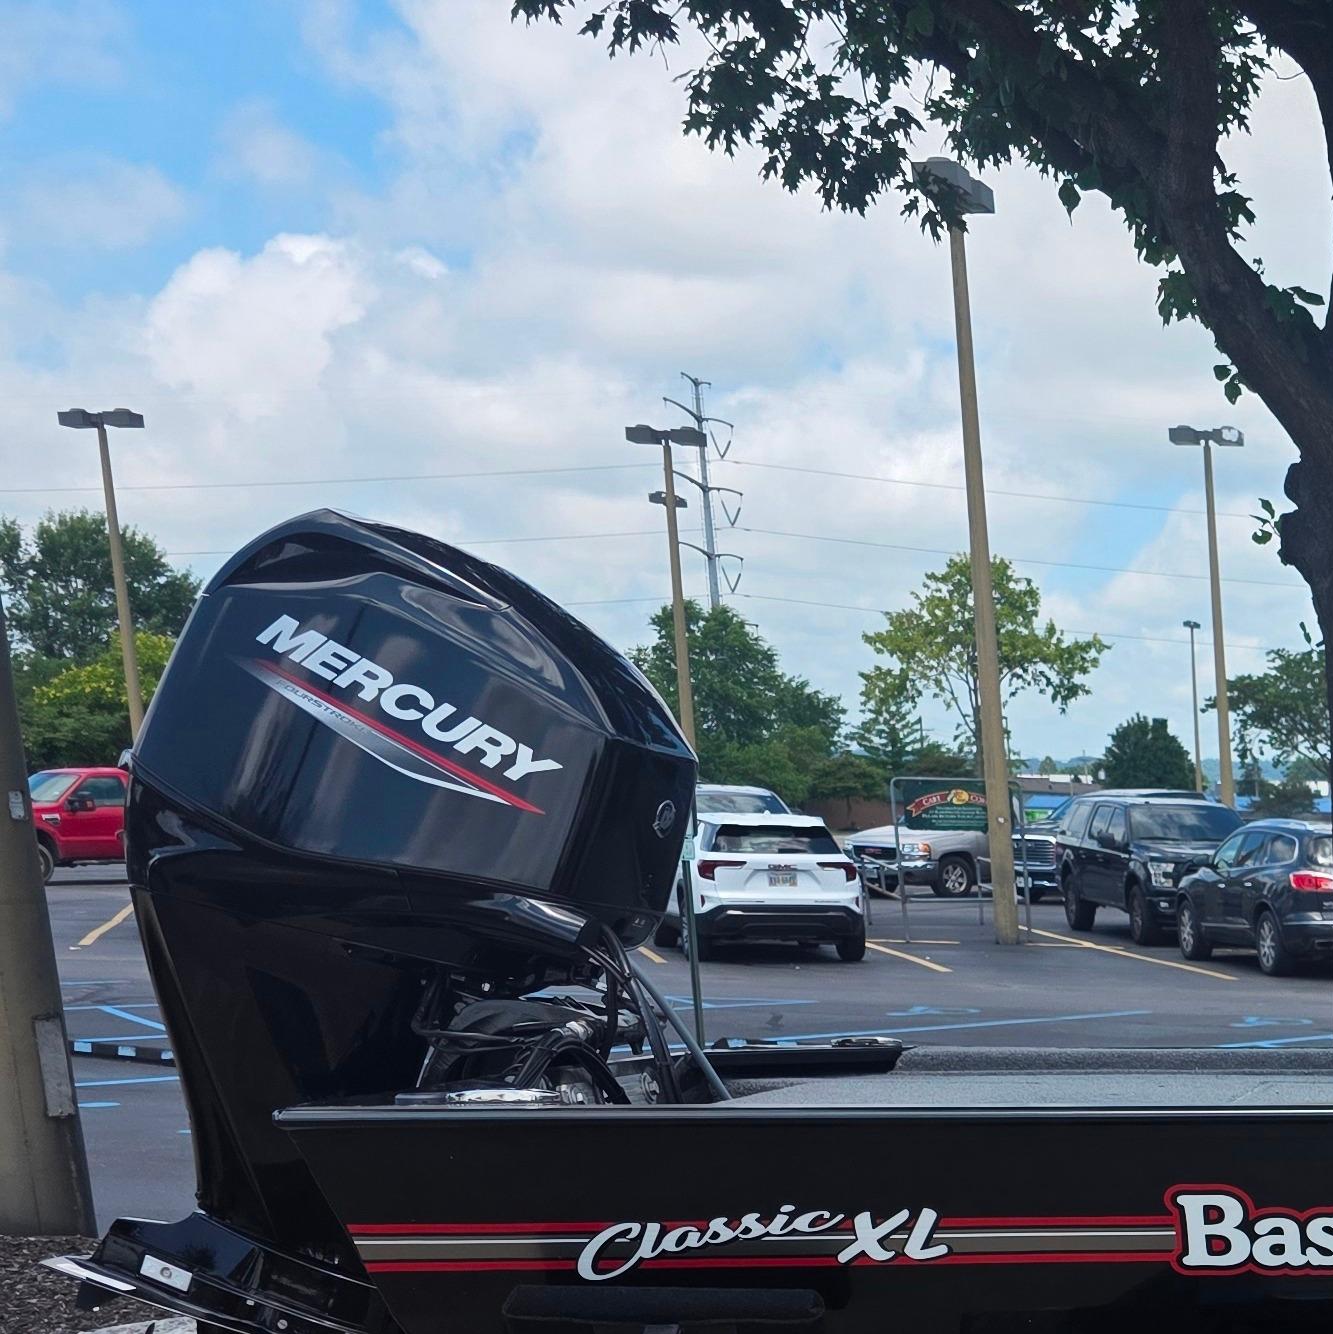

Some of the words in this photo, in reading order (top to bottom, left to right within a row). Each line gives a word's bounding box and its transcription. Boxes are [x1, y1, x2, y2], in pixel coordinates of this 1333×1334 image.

[255, 614, 563, 781] MERCURY
[275, 678, 371, 736] FOURSTROKE
[577, 1204, 845, 1281] Classic
[837, 1207, 949, 1264] XL
